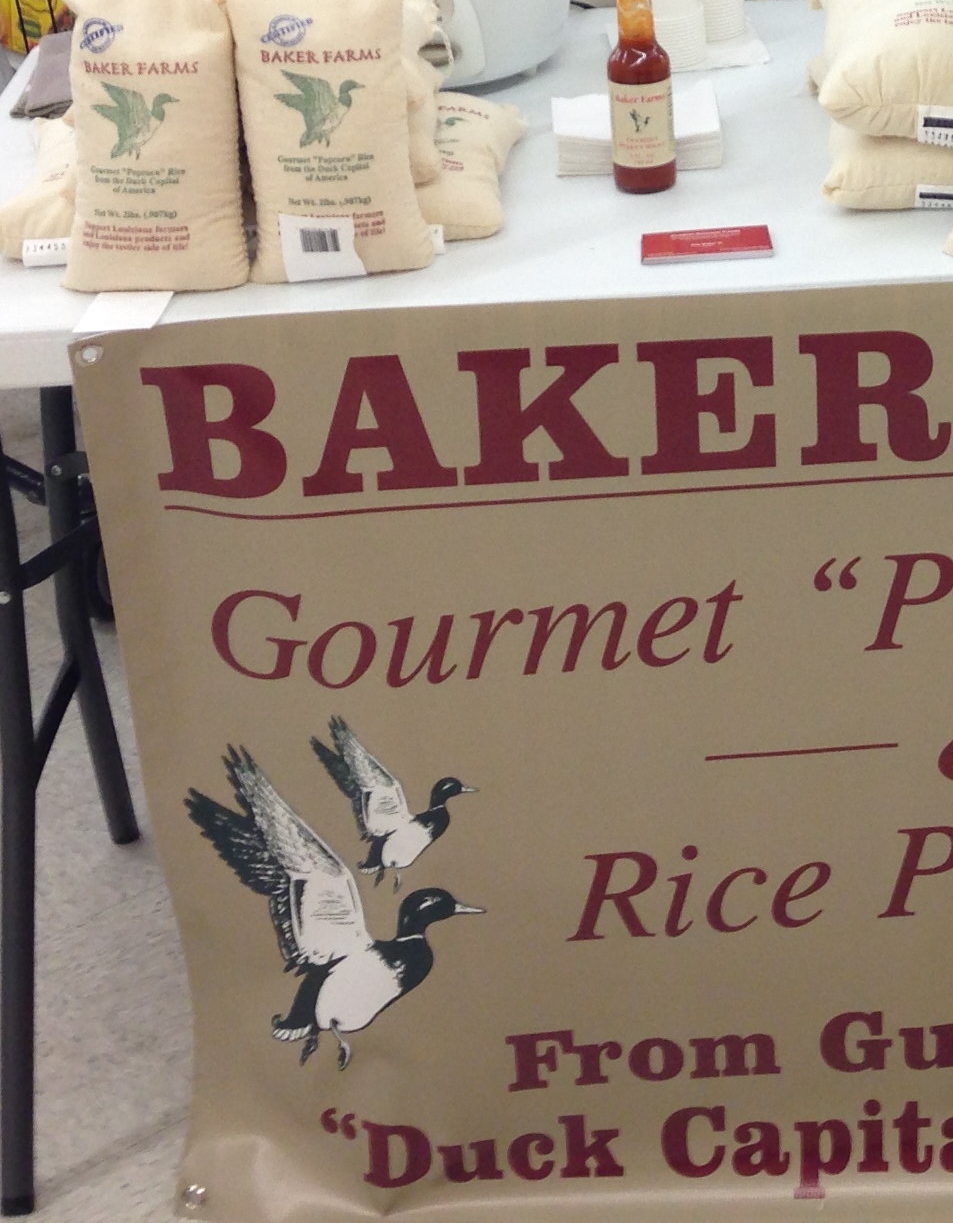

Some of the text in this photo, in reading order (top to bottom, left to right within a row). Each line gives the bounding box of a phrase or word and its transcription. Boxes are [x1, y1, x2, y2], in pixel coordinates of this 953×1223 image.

[83, 60, 199, 76] BAKER FARMS
[260, 48, 381, 64] BAKER FARMS
[141, 330, 952, 499] BAKER
[211, 580, 743, 689] Gourmet
[566, 844, 832, 942] Rice
[505, 1029, 781, 1092] From
[320, 1107, 624, 1189] “Duck
